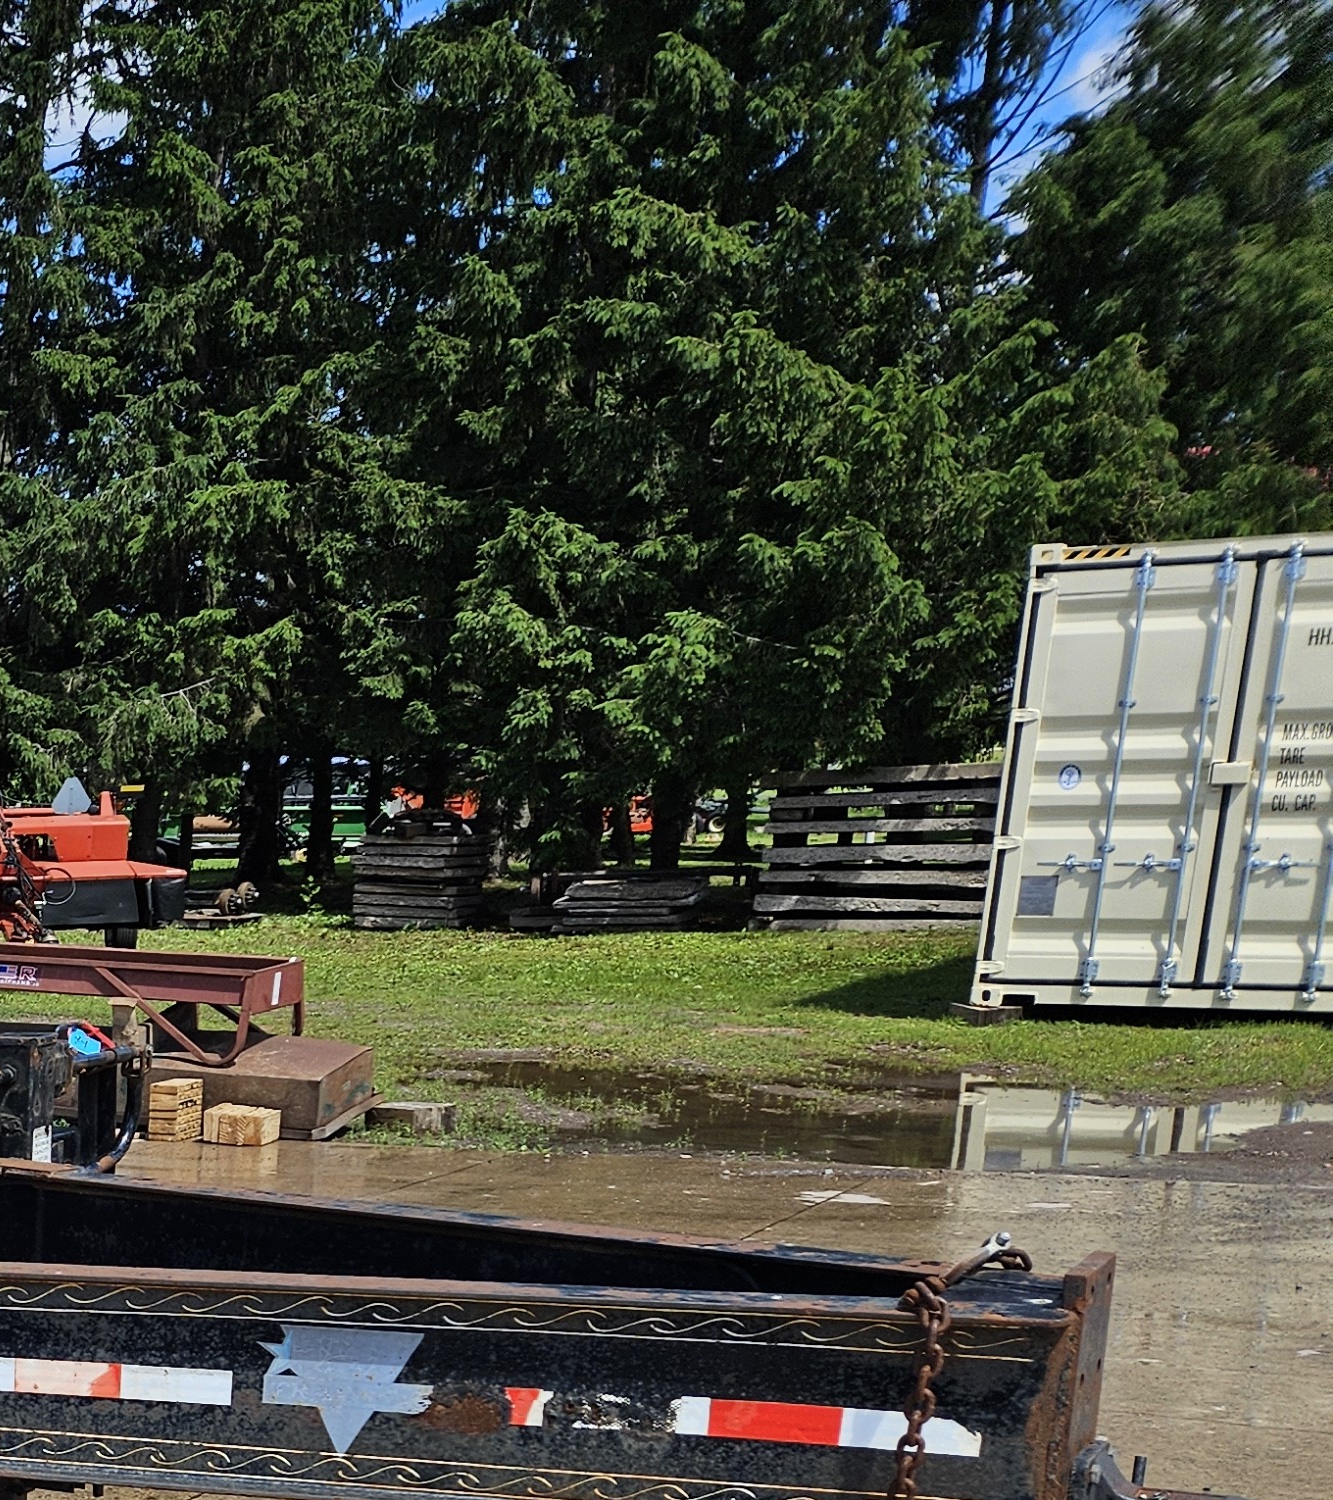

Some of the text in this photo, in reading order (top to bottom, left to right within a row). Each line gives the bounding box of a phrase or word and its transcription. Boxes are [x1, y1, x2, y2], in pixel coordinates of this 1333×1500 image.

[1308, 627, 1333, 645] HH
[1279, 747, 1306, 765] TARE
[1275, 769, 1323, 788] PAYLOAD
[1271, 794, 1288, 811] CU.
